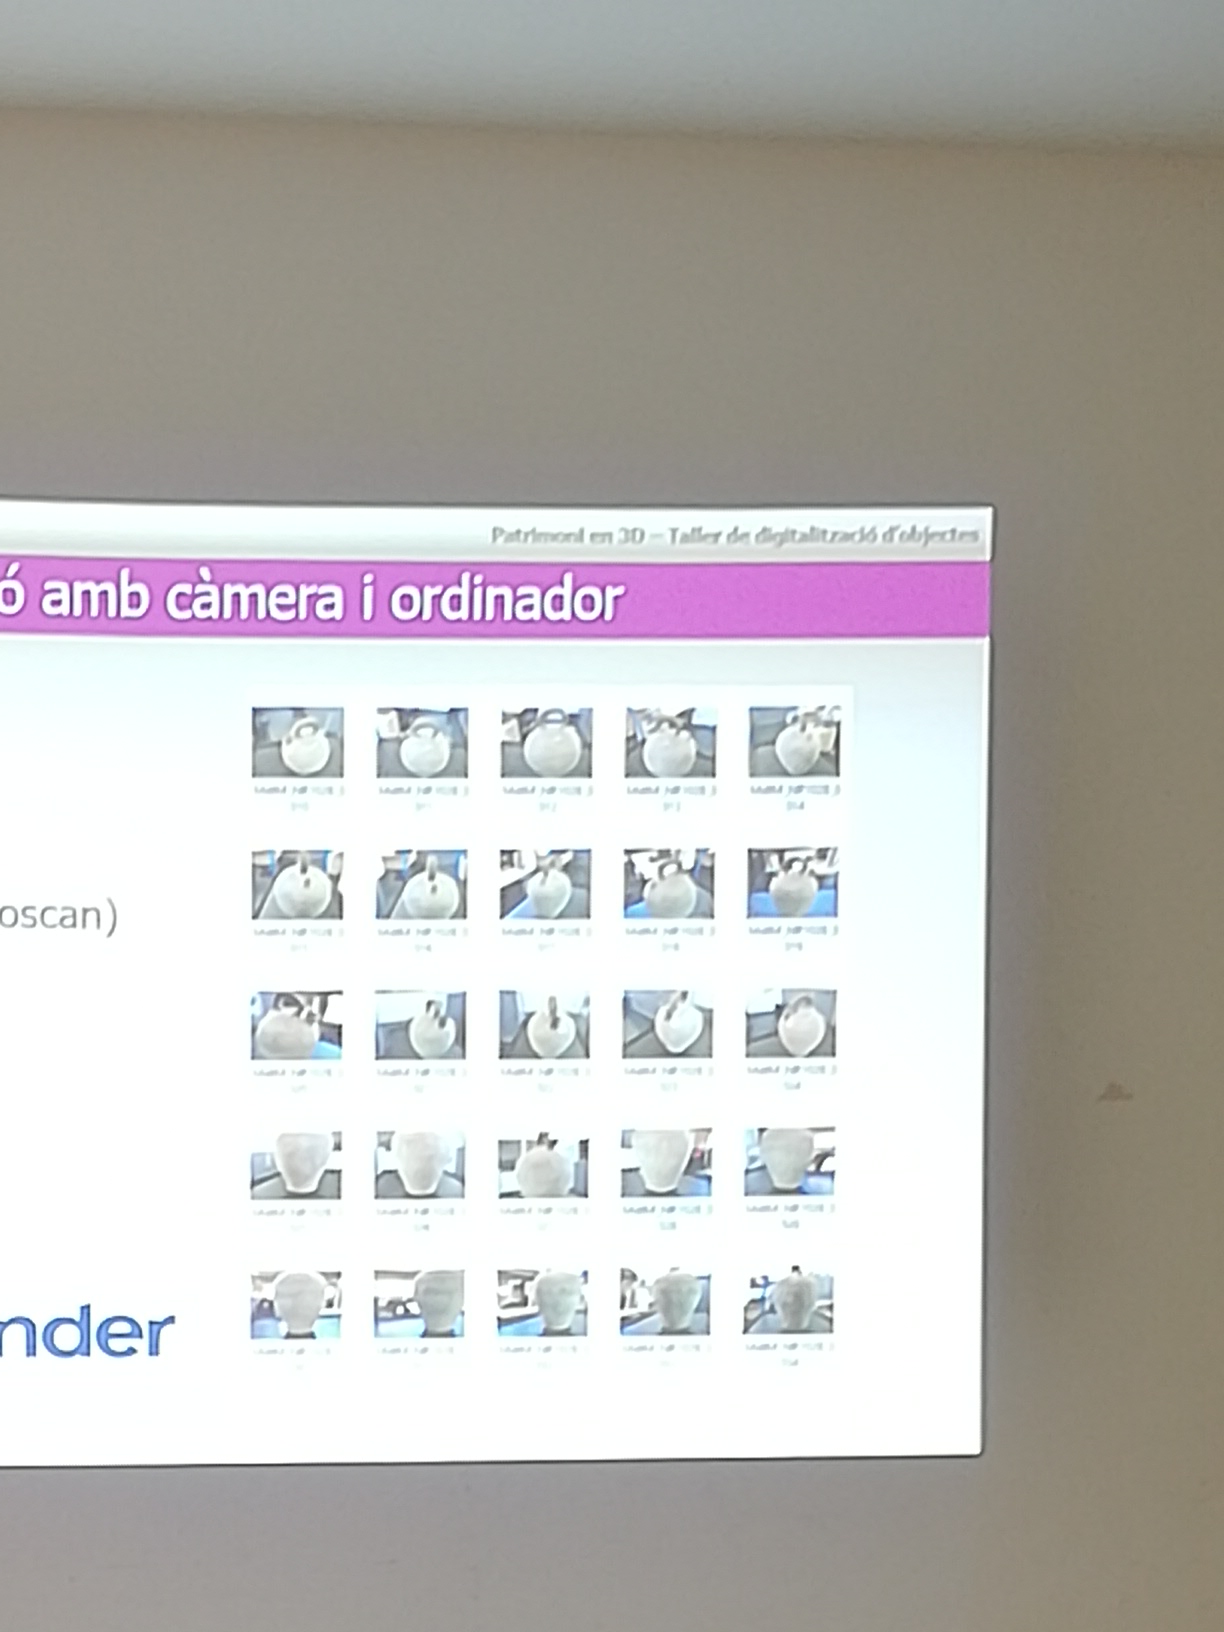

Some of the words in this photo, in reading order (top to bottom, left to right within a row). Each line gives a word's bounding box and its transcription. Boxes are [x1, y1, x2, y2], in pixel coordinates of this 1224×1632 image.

[491, 526, 585, 546] Patrimoni
[589, 529, 614, 546] en
[618, 526, 646, 546] 3D
[669, 526, 723, 546] Taller
[726, 525, 751, 546] de
[754, 525, 878, 549] digitalització
[881, 525, 981, 549] d'objectes
[41, 567, 150, 618] amb
[166, 566, 344, 622] càmera
[362, 573, 375, 621] i
[391, 571, 626, 622] ordinador
